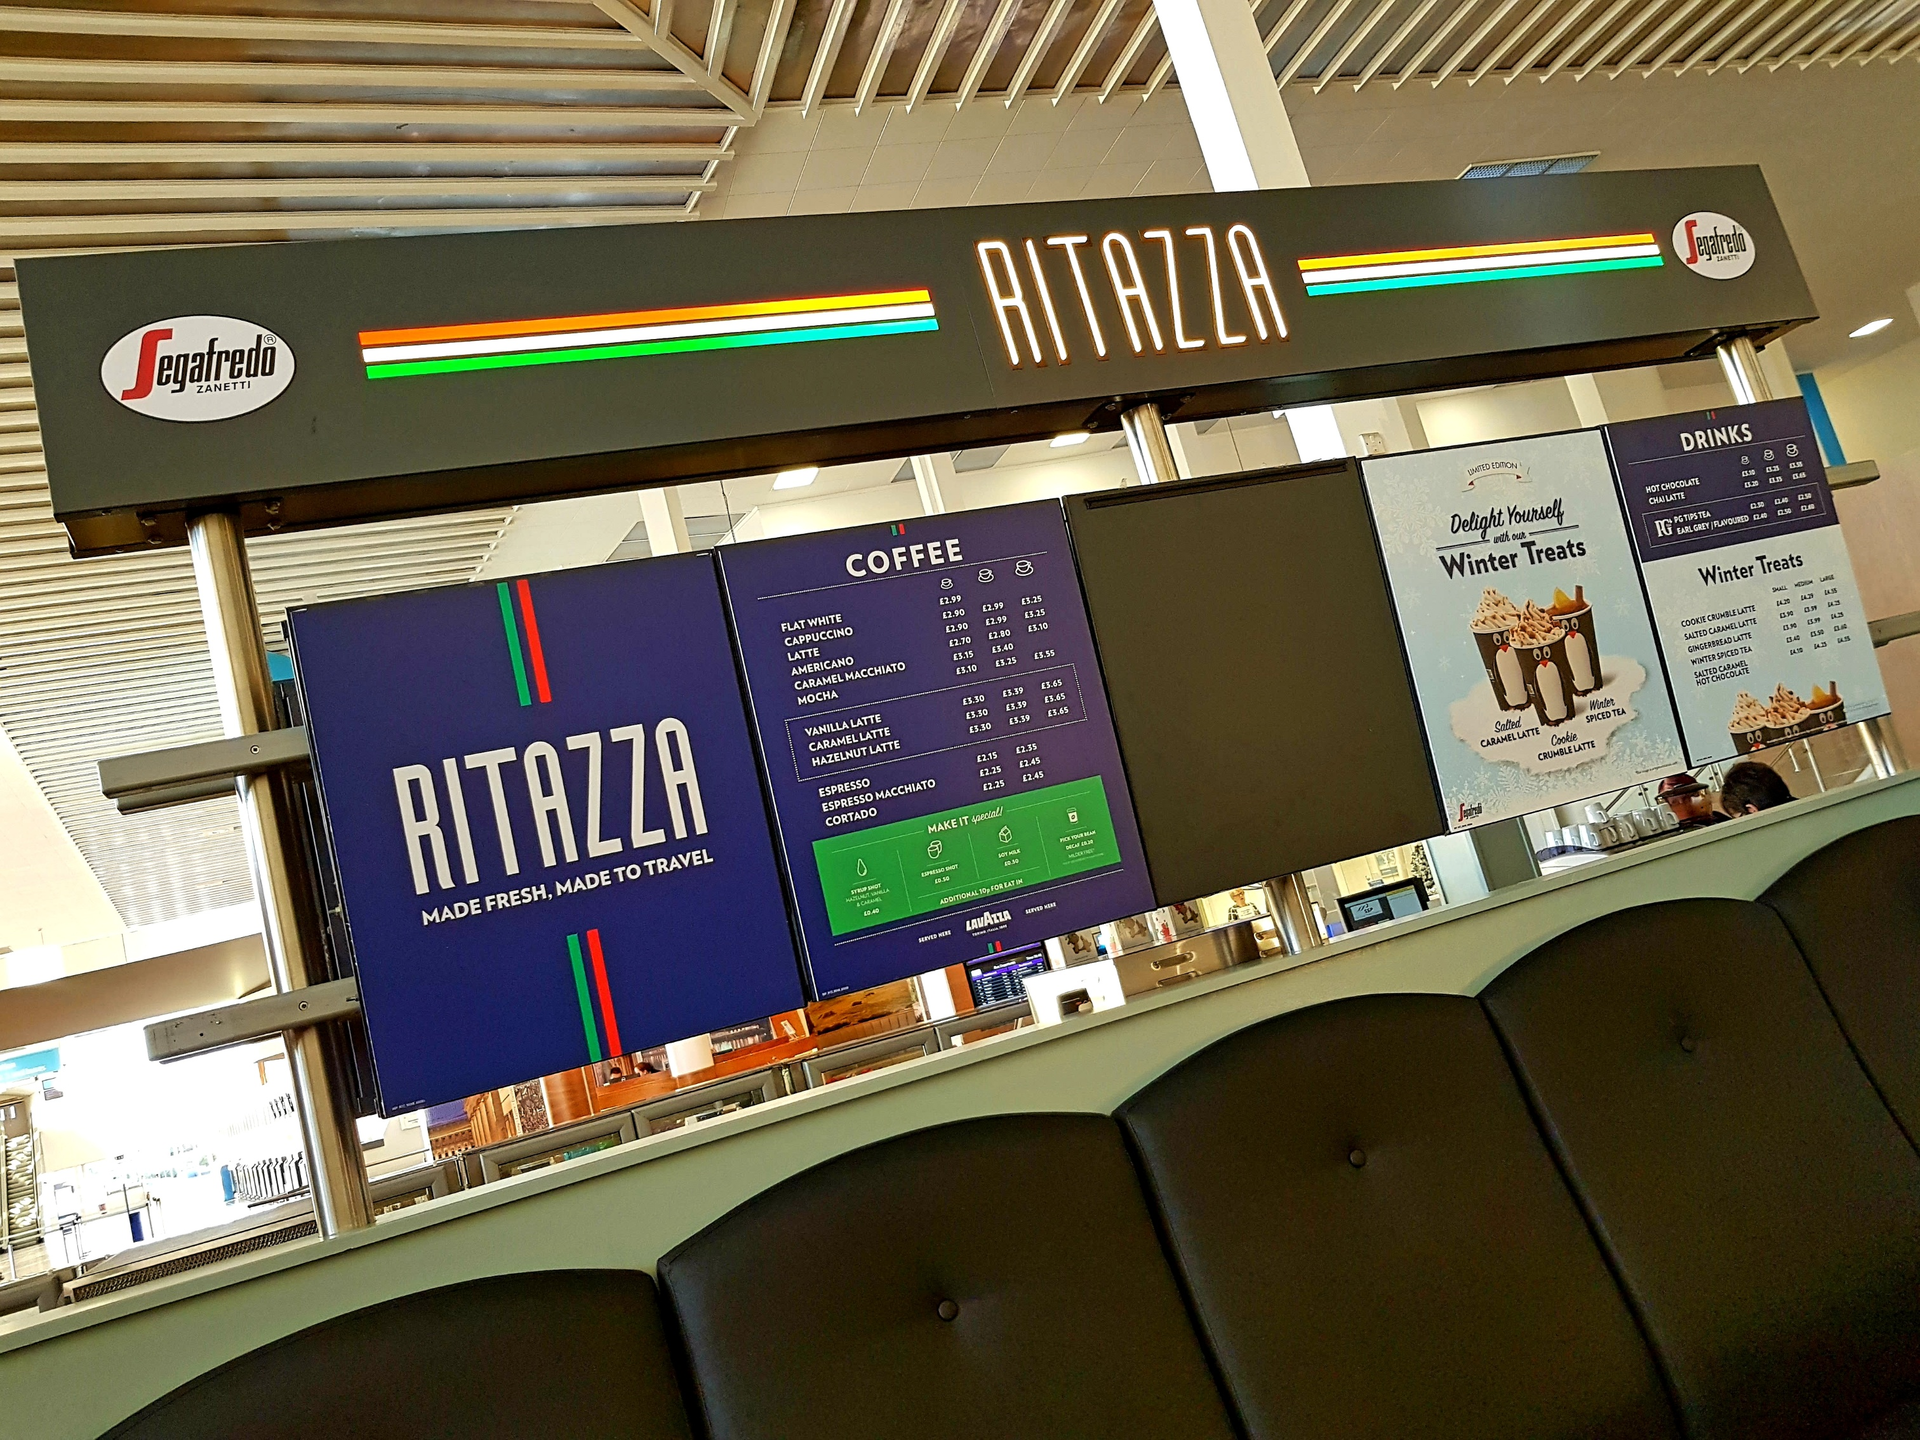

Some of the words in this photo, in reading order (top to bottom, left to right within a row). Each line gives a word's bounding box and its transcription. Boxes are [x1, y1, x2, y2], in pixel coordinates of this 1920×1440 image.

[1716, 254, 1740, 262] ZANETTI
[974, 223, 1289, 369] RITAZZA
[196, 381, 251, 393] ZANETTI
[1680, 424, 1753, 452] DRINKS
[1467, 464, 1490, 476] LIMITED
[1646, 484, 1660, 493] HOT
[1661, 478, 1700, 490] CHOCOLATE
[1649, 496, 1665, 505] CHAI
[1666, 492, 1685, 501] LATTE
[1450, 507, 1504, 540] Delight
[1507, 498, 1564, 526] Yourself
[1674, 515, 1684, 523] PG
[1684, 512, 1698, 520] TIPS
[1677, 525, 1693, 535] EARL
[1693, 522, 1710, 532] GREY
[1714, 515, 1749, 528] FLAVOURED
[1493, 531, 1510, 544] with
[1512, 531, 1526, 541] our
[845, 538, 964, 578] COFFEE
[1439, 552, 1518, 580] Winter
[1520, 539, 1586, 565] Treats
[1698, 564, 1754, 586] Winter
[1755, 553, 1804, 574] Treats
[781, 620, 805, 632] FLAT
[806, 613, 842, 627] WHITE
[940, 595, 961, 605] £2.99
[784, 627, 853, 646] CAPPUCCINO
[942, 608, 965, 619] £2.90
[982, 602, 1003, 612] £2.99
[1022, 595, 1042, 605] £3.25
[1681, 616, 1706, 627] COOKIE
[1707, 609, 1736, 622] CRUMBLE
[1737, 605, 1756, 615] LATTE
[788, 648, 820, 661] LATTE
[946, 622, 968, 633] £2.90
[986, 616, 1006, 626] £2.99
[1024, 608, 1045, 619] £3.25
[1684, 629, 1707, 640] SALTED
[1709, 622, 1738, 635] CARAMEL
[1738, 618, 1757, 628] LATTE
[791, 656, 854, 676] AMERICANO
[949, 636, 971, 647] £2.70
[988, 629, 1010, 640] £2.80
[1028, 622, 1048, 632] £3.10
[1688, 637, 1732, 653] GINGERBREAD
[1733, 632, 1752, 642] LATTE
[794, 673, 844, 690] CARAMEL
[845, 662, 905, 681] MACCHIATO
[953, 650, 974, 661] £3.15
[992, 643, 1014, 653] £3.40
[1690, 654, 1717, 666] WINTER
[1717, 649, 1739, 660] SPICED
[1740, 646, 1752, 654] TEA
[797, 690, 838, 705] MOCHA
[956, 664, 977, 675] £3.10
[996, 657, 1016, 667] £3.25
[1034, 650, 1055, 660] £3.55
[1694, 667, 1718, 678] SALTED
[1718, 660, 1748, 672] CARAMEL
[1696, 677, 1710, 686] HOT
[1712, 667, 1750, 682] CHOCOLATE
[804, 721, 849, 736] VANILLA
[850, 714, 881, 728] LATTE
[962, 695, 985, 706] £3.30
[1002, 687, 1024, 697] £3.39
[1041, 679, 1062, 690] £3.65
[1589, 697, 1615, 712] Winter
[808, 734, 858, 752] CARAMEL
[859, 727, 890, 741] LATTE
[966, 709, 988, 719] £3.30
[1006, 701, 1027, 711] £3.39
[1044, 693, 1065, 703] £3.65
[1494, 716, 1521, 733] Salted
[1586, 711, 1611, 723] SPICED
[1612, 708, 1626, 718] TEA
[812, 747, 867, 766] HAZELNUT
[869, 740, 900, 754] LATTE
[969, 723, 991, 733] £3.30
[1009, 714, 1030, 725] £3.39
[1048, 706, 1069, 717] £3.65
[1480, 734, 1517, 748] CARAMEL
[1517, 727, 1540, 739] LATTE
[1551, 731, 1578, 746] Cookie
[1538, 746, 1573, 761] CRUMBLE
[1573, 741, 1596, 753] LATTE
[819, 778, 870, 797] ESPRESSO
[977, 752, 998, 762] £2.15
[1016, 743, 1037, 754] £2.35
[822, 793, 873, 812] ESPRESSO
[876, 779, 936, 800] MACCHIATO
[980, 766, 1001, 777] £2.25
[1019, 757, 1040, 768] £2.45
[392, 717, 708, 896] RITAZZA
[825, 808, 877, 826] CORTADO
[983, 780, 1005, 791] £2.25
[1023, 771, 1044, 782] £2.45
[927, 818, 957, 834] MAKE
[959, 816, 969, 826] IT
[972, 806, 1003, 824] special!
[921, 868, 945, 877] ESPRESSO
[421, 899, 482, 927] MADE
[485, 884, 553, 913] FRESH,
[555, 870, 611, 896] MADE
[614, 864, 642, 884] TO
[644, 849, 714, 877] TRAVEL
[851, 887, 867, 895] SYRUP
[868, 883, 881, 891] SHOT
[871, 888, 890, 897] VANILLA
[940, 890, 978, 905] ADDITIONAL
[1025, 905, 1043, 914] SERVED
[1044, 902, 1056, 910] HERE
[918, 934, 937, 943] SERVED
[938, 930, 951, 938] HERE
